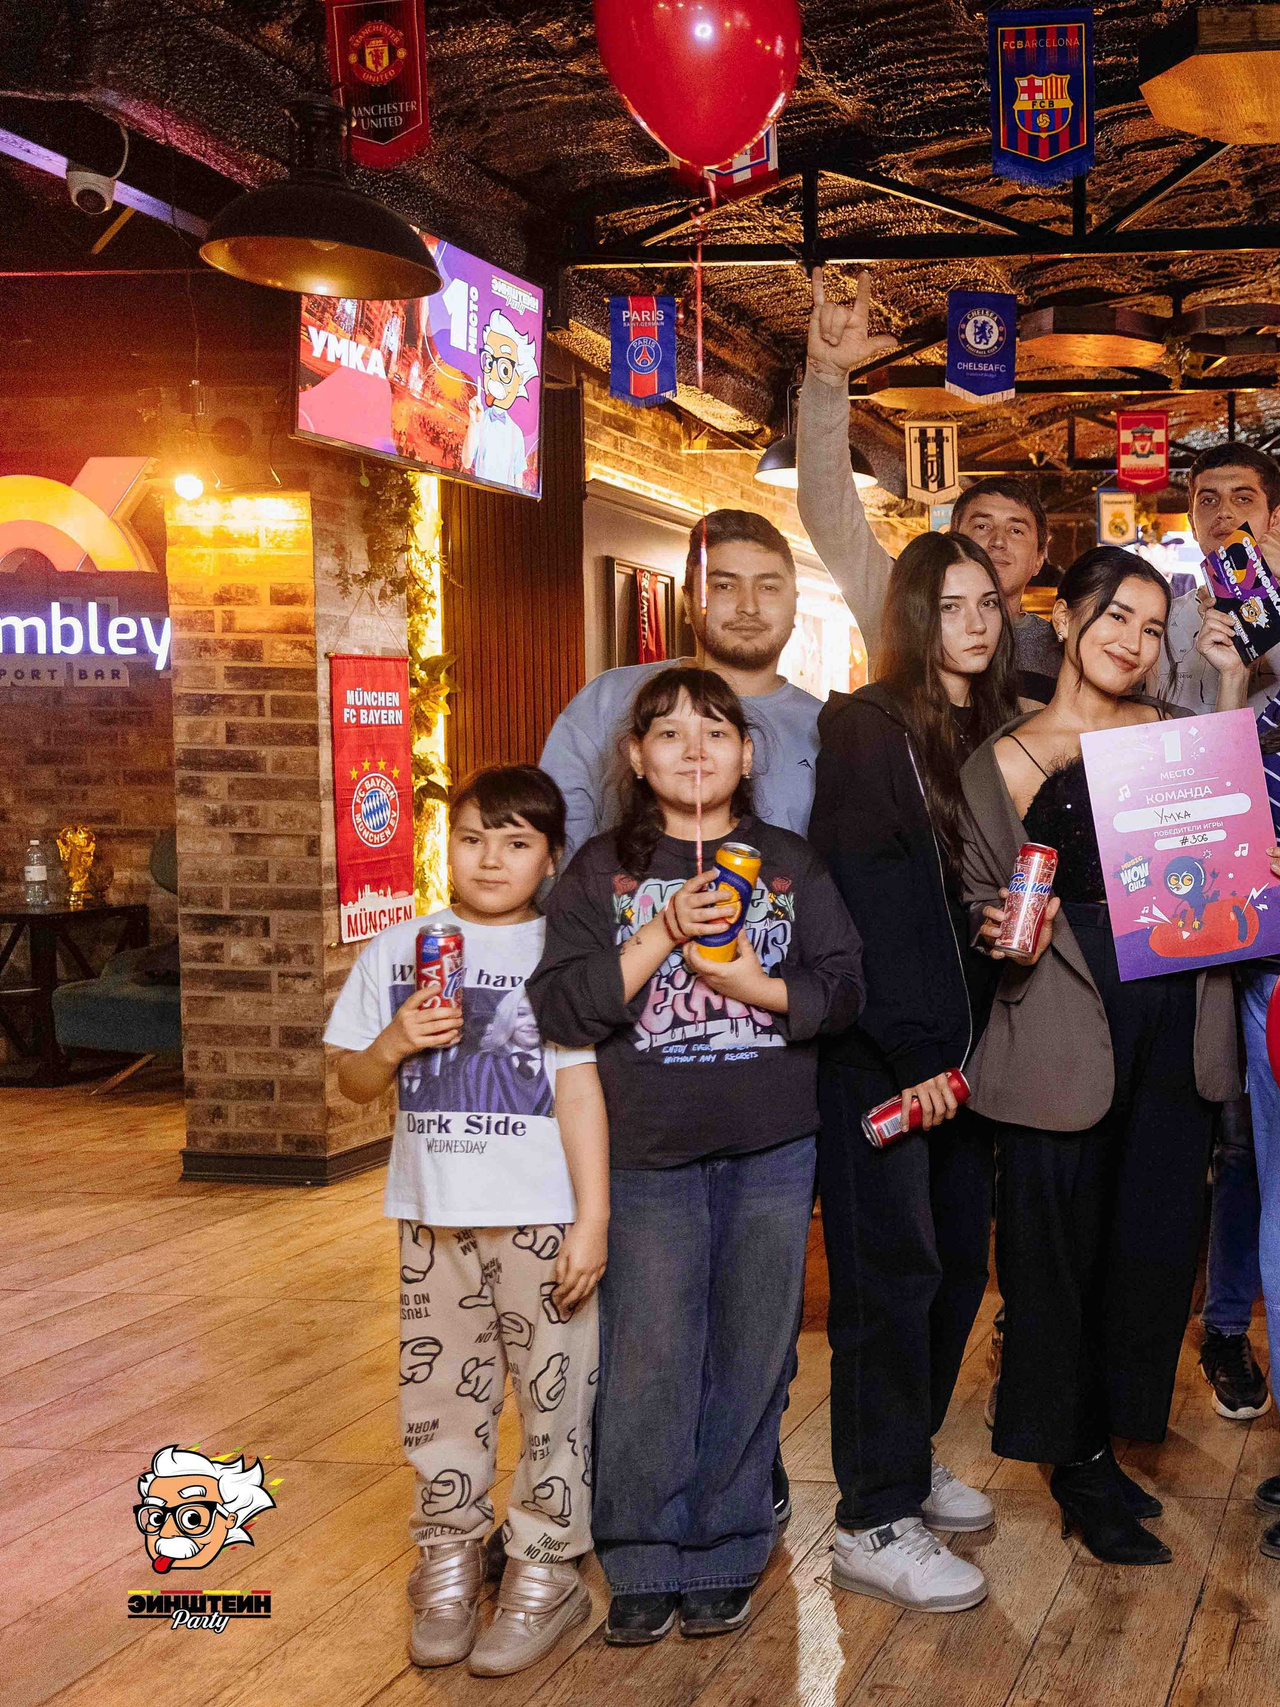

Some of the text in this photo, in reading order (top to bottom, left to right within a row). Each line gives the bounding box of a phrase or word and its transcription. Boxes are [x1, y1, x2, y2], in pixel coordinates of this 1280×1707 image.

[353, 25, 400, 47] MANCHESTER
[362, 69, 396, 82] UNITED
[1032, 100, 1055, 109] FCB
[361, 116, 403, 130] UNITED
[442, 277, 469, 351] 1
[469, 285, 479, 355] МЕСТО
[622, 309, 665, 322] PARIS
[967, 308, 998, 322] CHELSEA
[307, 325, 387, 379] УМКА
[632, 338, 656, 349] PARIS
[78, 668, 121, 681] BAR
[346, 688, 399, 707] MÜNCHEN
[343, 708, 403, 725] FC BAYERN
[1159, 730, 1182, 763] 1
[1160, 767, 1195, 781] МЕСТО
[364, 777, 395, 800] BAYERN
[1146, 785, 1213, 805] КОМАНДА
[1153, 821, 1224, 838] ПОБЕДИТЕЛИ ИГРЫ
[1121, 854, 1144, 871] MUSIC
[1120, 861, 1149, 886] WOW
[1128, 879, 1148, 893] QUIZ
[347, 904, 412, 938] MÜNCHEN
[477, 969, 524, 987] hav
[663, 1051, 758, 1064] WITHOUT ANY REGRETS
[407, 1113, 527, 1136] Dark Side
[426, 1137, 487, 1155] WEDNESDAY
[413, 1293, 430, 1304] NO
[407, 1418, 439, 1433] WORK
[403, 1432, 434, 1447] TEAM
[537, 1532, 571, 1552] TRUST
[523, 1544, 541, 1559] NO
